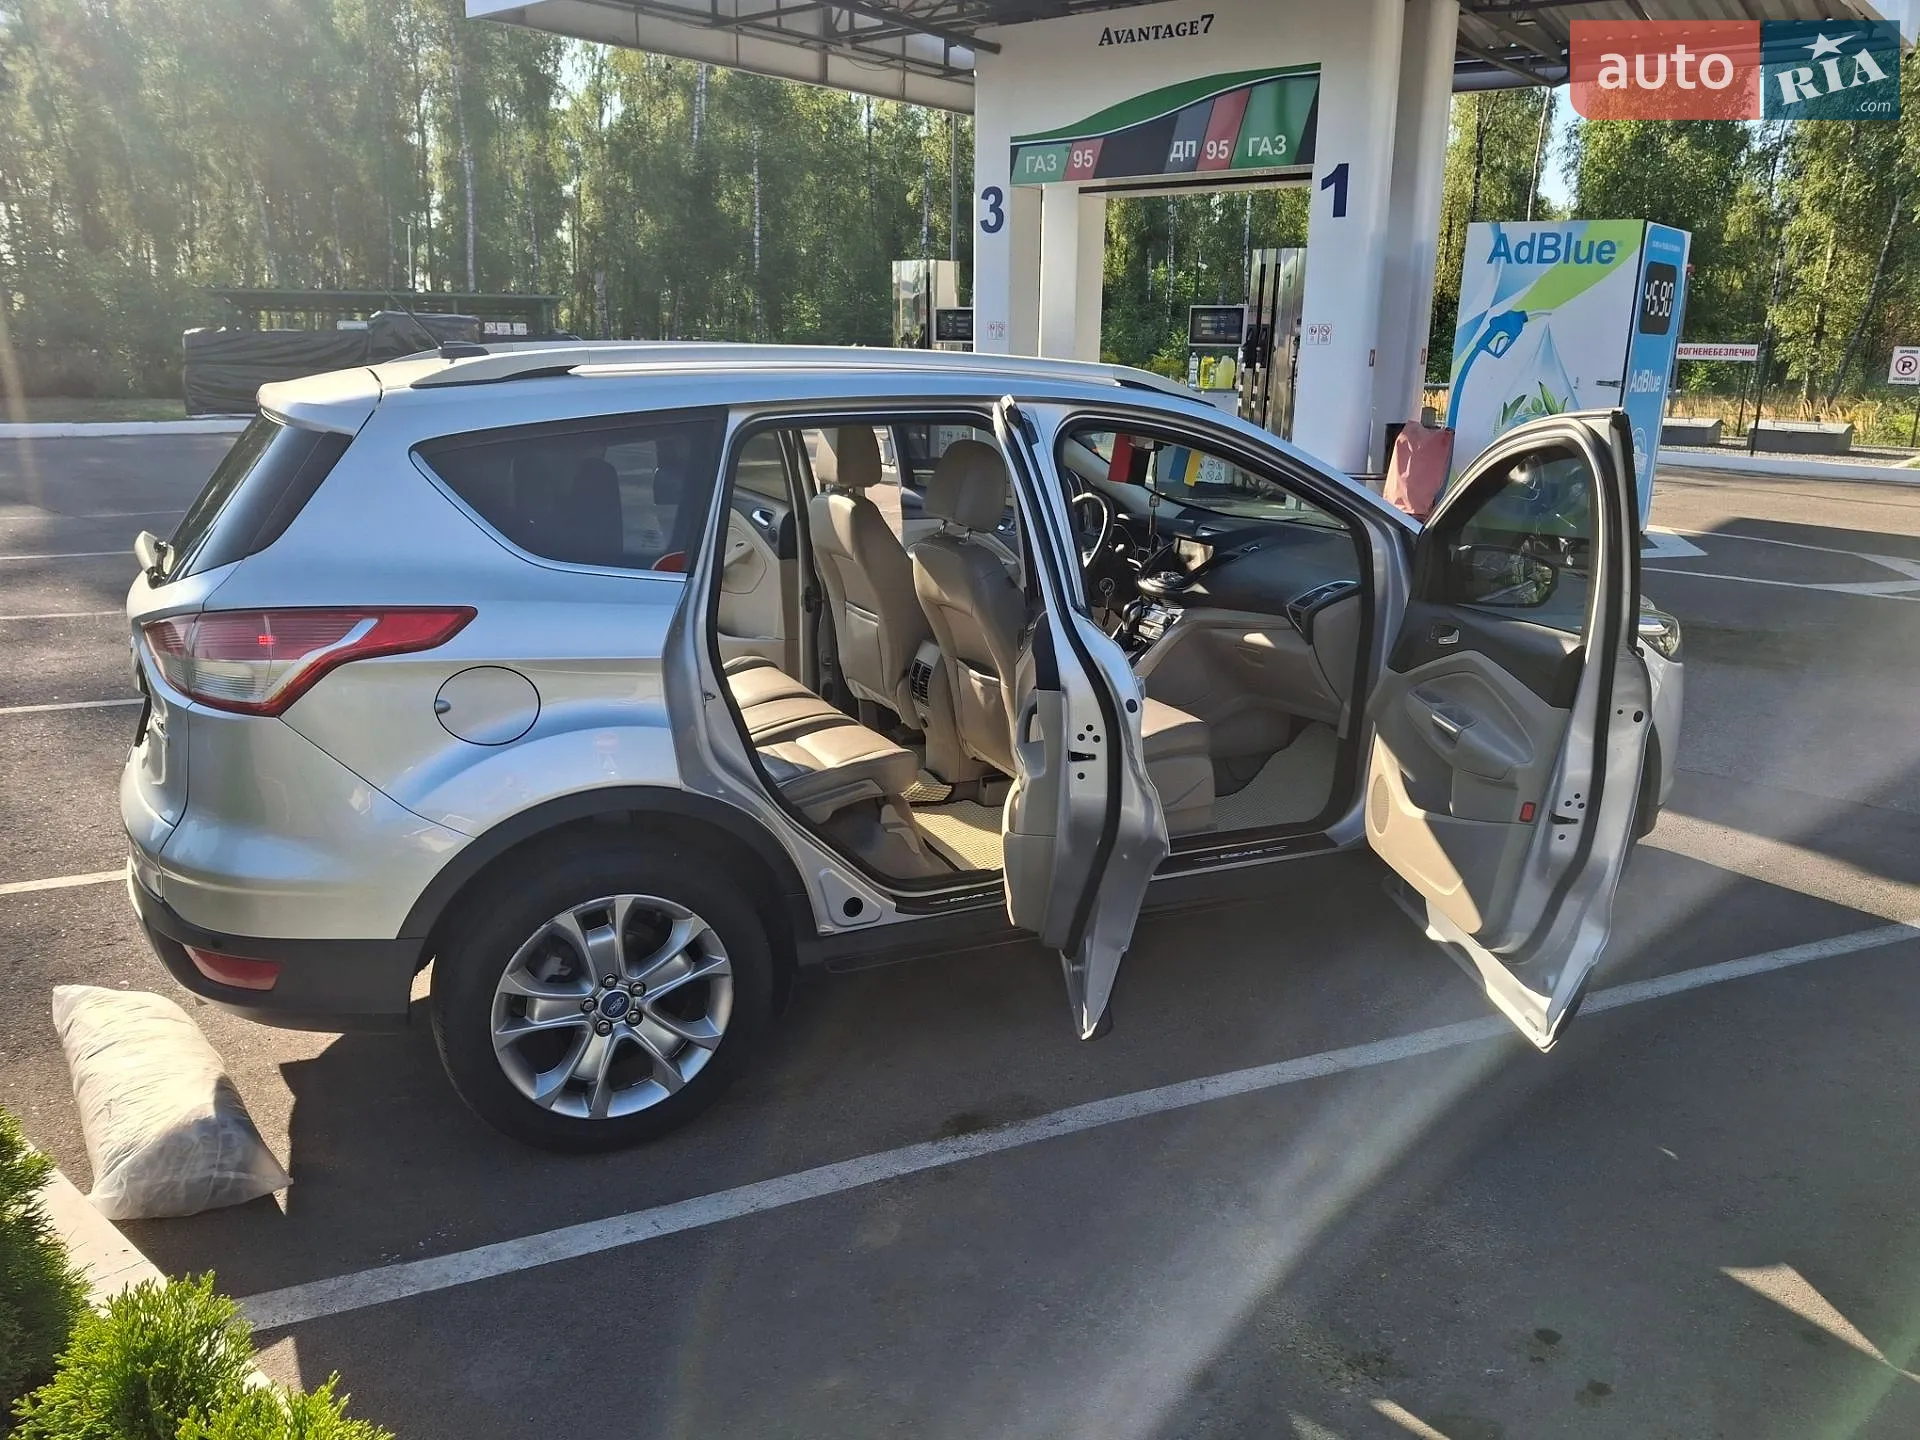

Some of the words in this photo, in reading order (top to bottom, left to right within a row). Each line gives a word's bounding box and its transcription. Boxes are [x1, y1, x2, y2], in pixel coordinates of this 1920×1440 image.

[1099, 14, 1214, 46] AVANTAGE7
[1169, 139, 1197, 162] ДП
[1206, 139, 1229, 160] 95
[1247, 135, 1286, 157] ГАЗ
[1025, 154, 1057, 173] ГАЗ
[1073, 150, 1094, 168] 95
[1320, 162, 1350, 218] 1
[979, 186, 1005, 233] 3
[1487, 232, 1617, 265] AdBlue
[1678, 347, 1756, 357] ВОГНЕНЕБЕЗПЕЧНО
[1629, 369, 1662, 393] AdBlue
